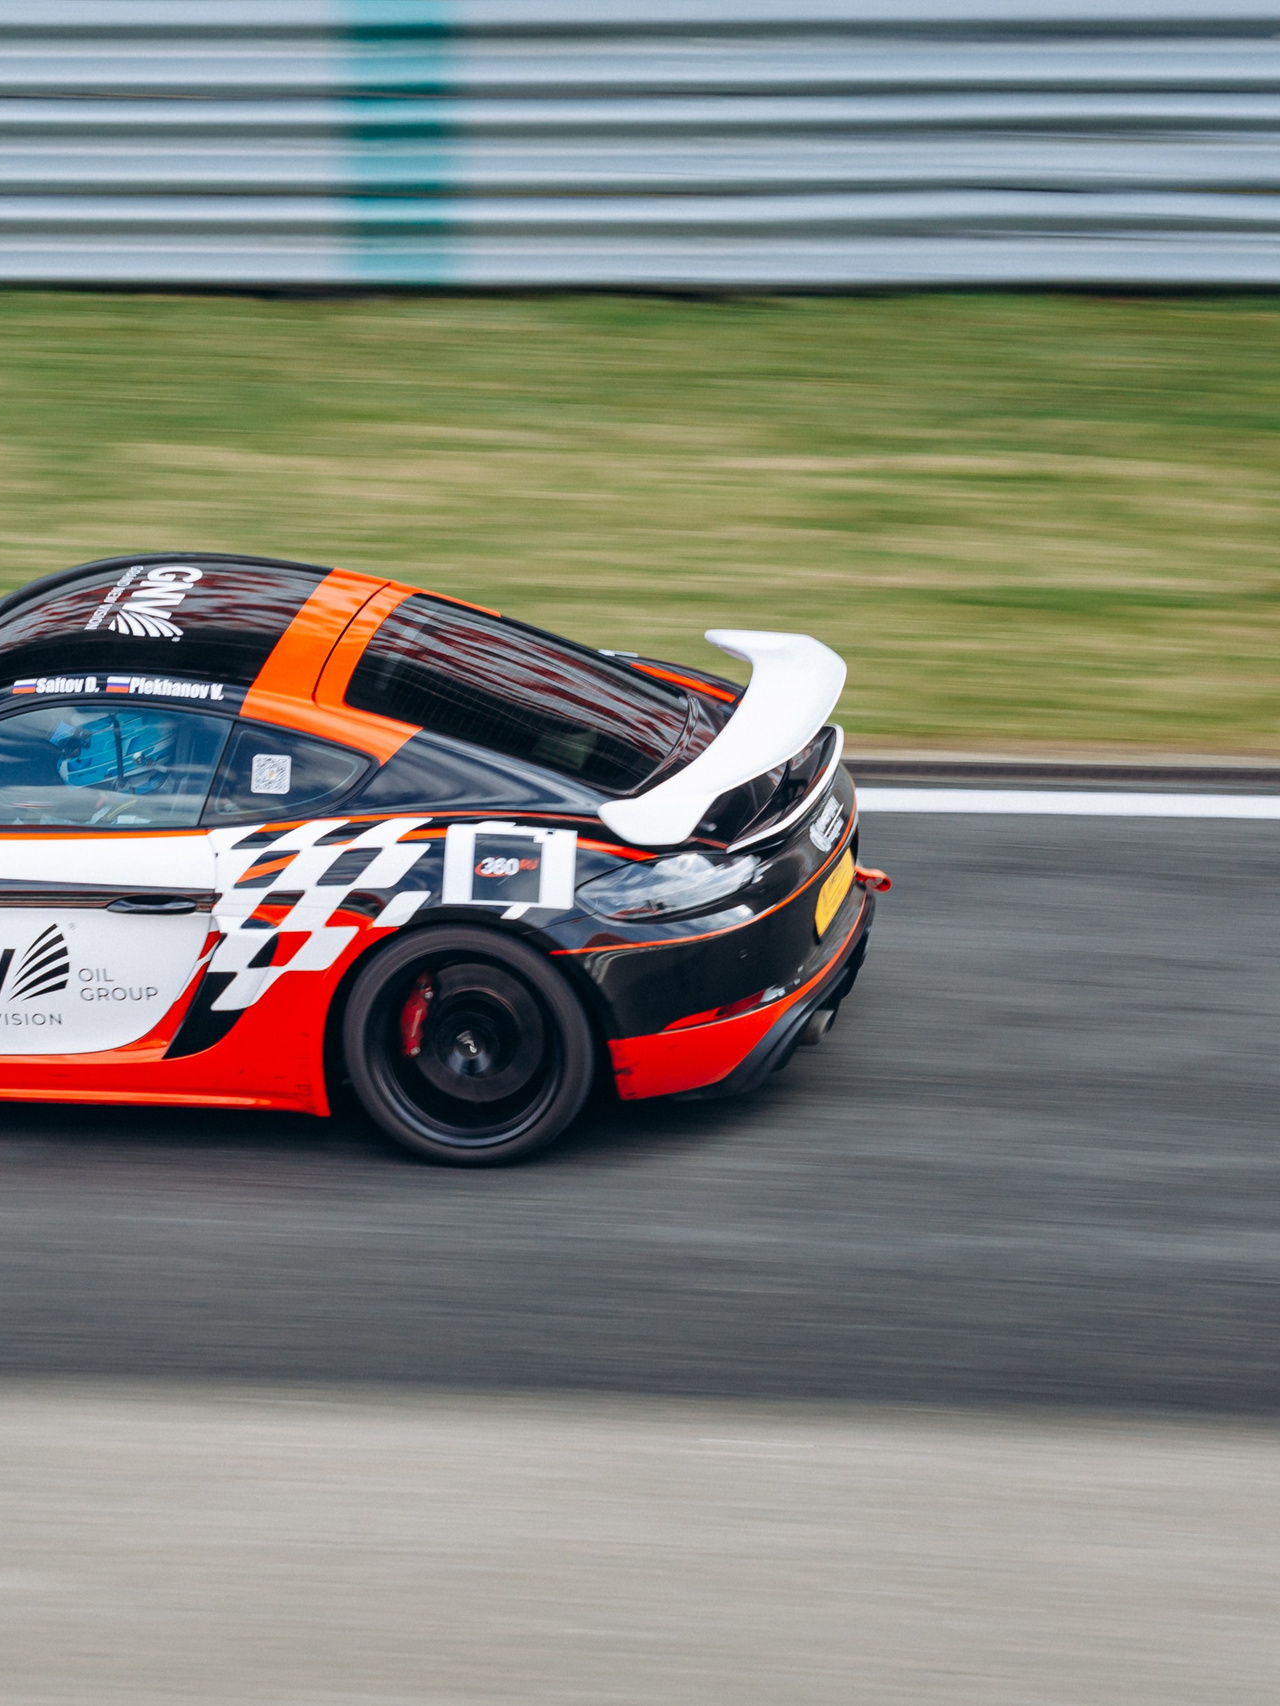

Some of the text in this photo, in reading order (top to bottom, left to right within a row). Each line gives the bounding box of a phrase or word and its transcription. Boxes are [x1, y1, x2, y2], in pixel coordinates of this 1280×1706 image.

[104, 586, 126, 604] NEW
[122, 565, 203, 620] GNV
[84, 603, 113, 630] VISION
[85, 676, 100, 693] D.
[129, 677, 210, 699] Plekhanov
[78, 967, 115, 983] OIL
[80, 986, 159, 1002] GROUP
